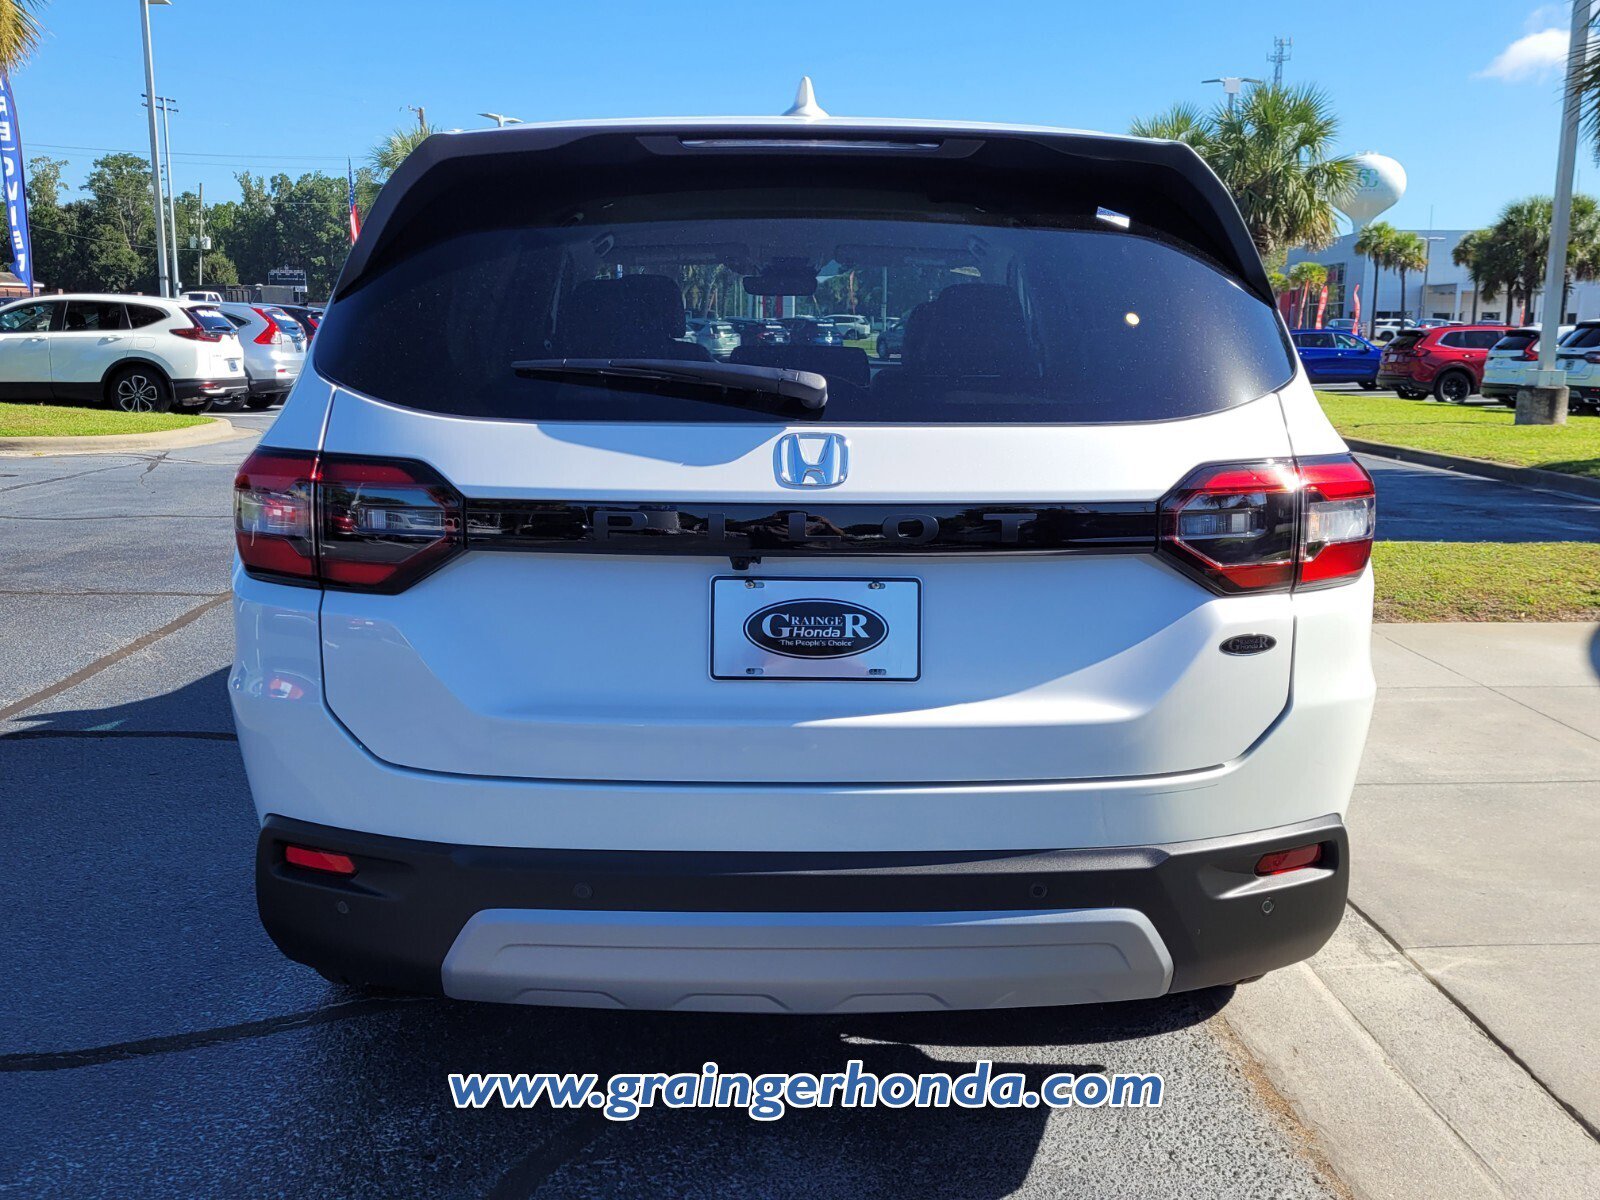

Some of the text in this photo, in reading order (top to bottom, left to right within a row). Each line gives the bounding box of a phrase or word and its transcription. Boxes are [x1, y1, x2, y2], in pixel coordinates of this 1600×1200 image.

[593, 510, 1038, 544] PILOT
[761, 613, 870, 638] GRAINGER
[792, 626, 841, 638] Honda
[795, 639, 826, 647] People's
